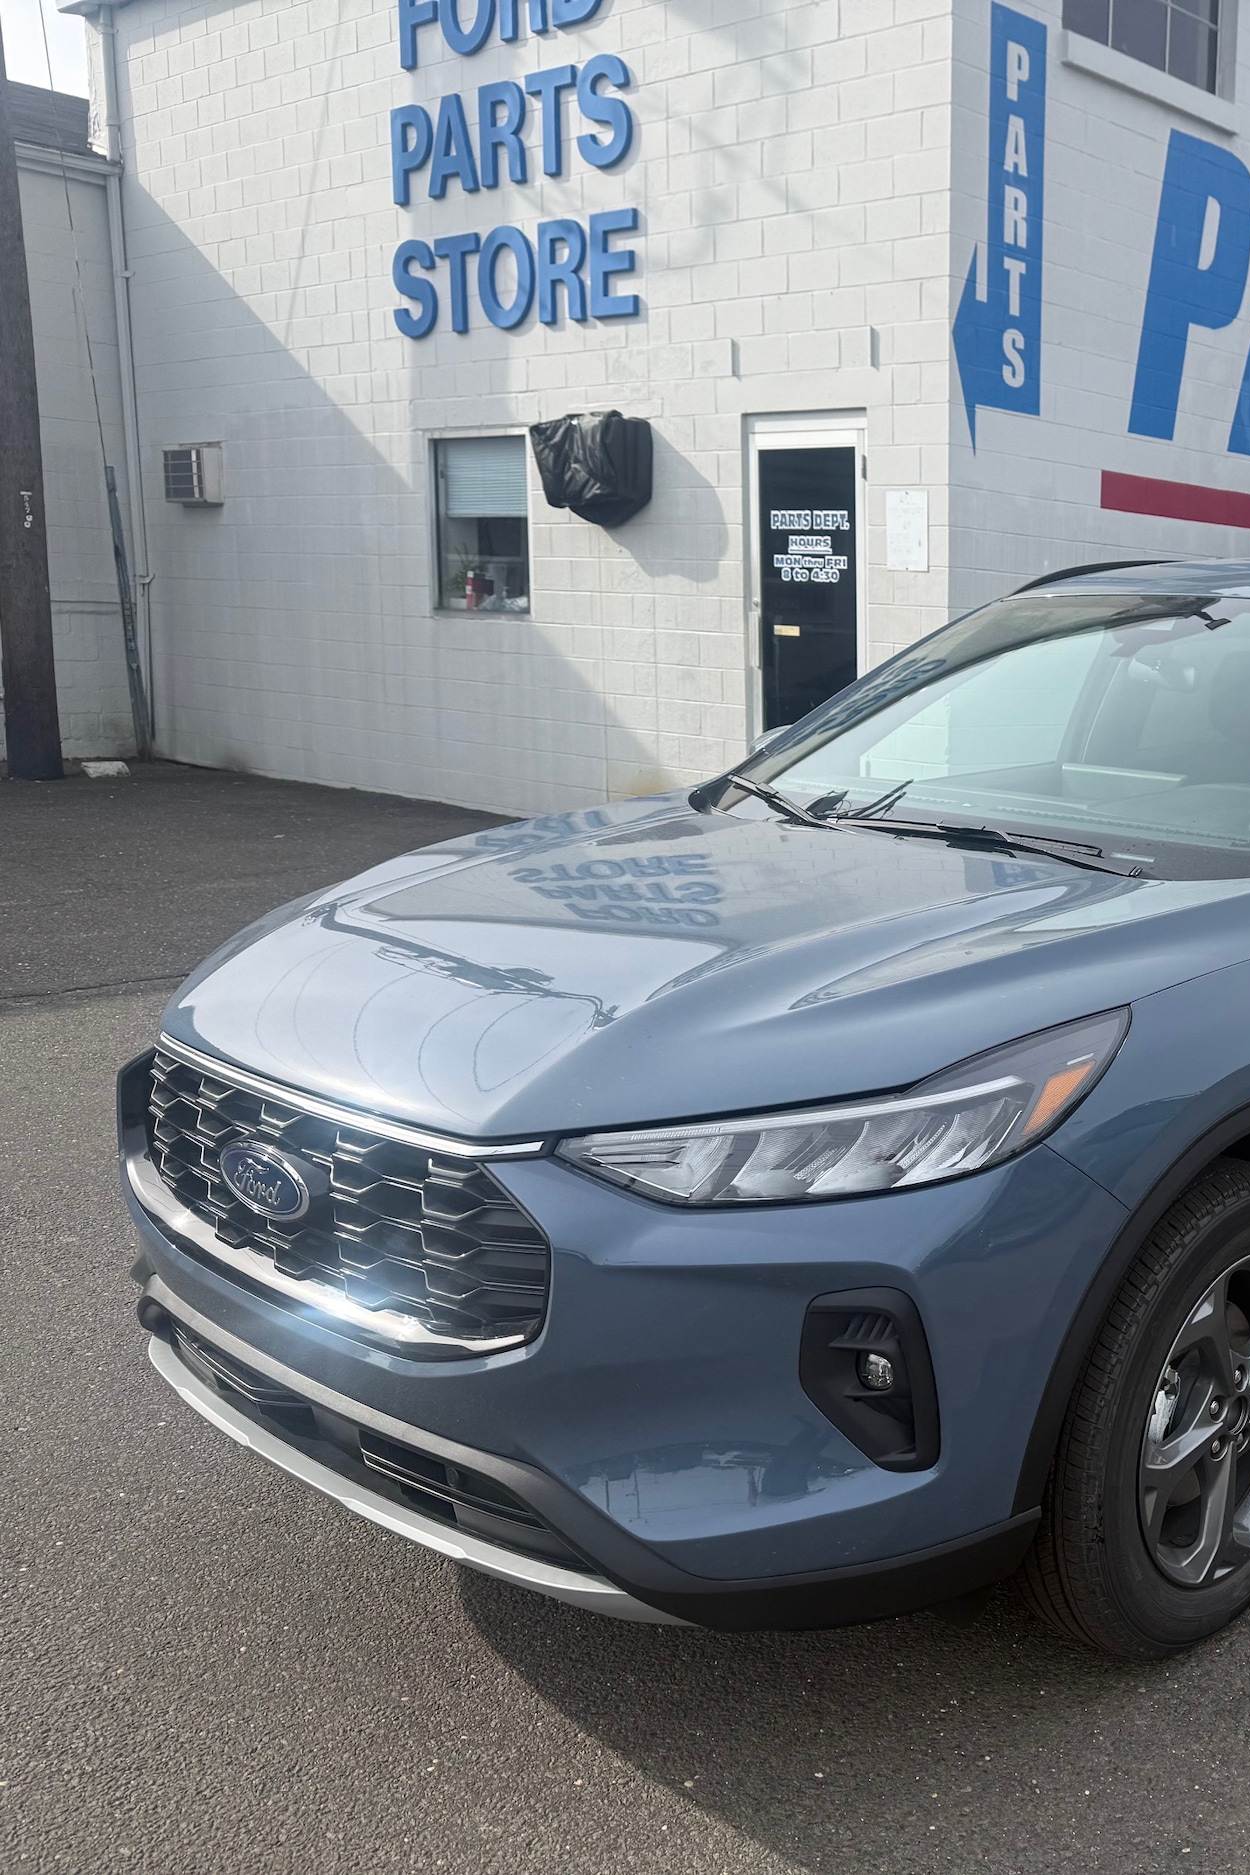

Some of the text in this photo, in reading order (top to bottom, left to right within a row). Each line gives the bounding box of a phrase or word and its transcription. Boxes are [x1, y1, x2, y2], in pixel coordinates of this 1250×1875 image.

[390, 53, 634, 206] PARTS
[1002, 40, 1030, 389] PARTS
[392, 208, 640, 339] STORE
[770, 510, 850, 531] PARTS DEPT.
[788, 536, 832, 550] HOURS
[773, 554, 848, 569] MON thru FRI
[781, 567, 840, 583] 8 to 4:30
[233, 1156, 283, 1207] Ford
